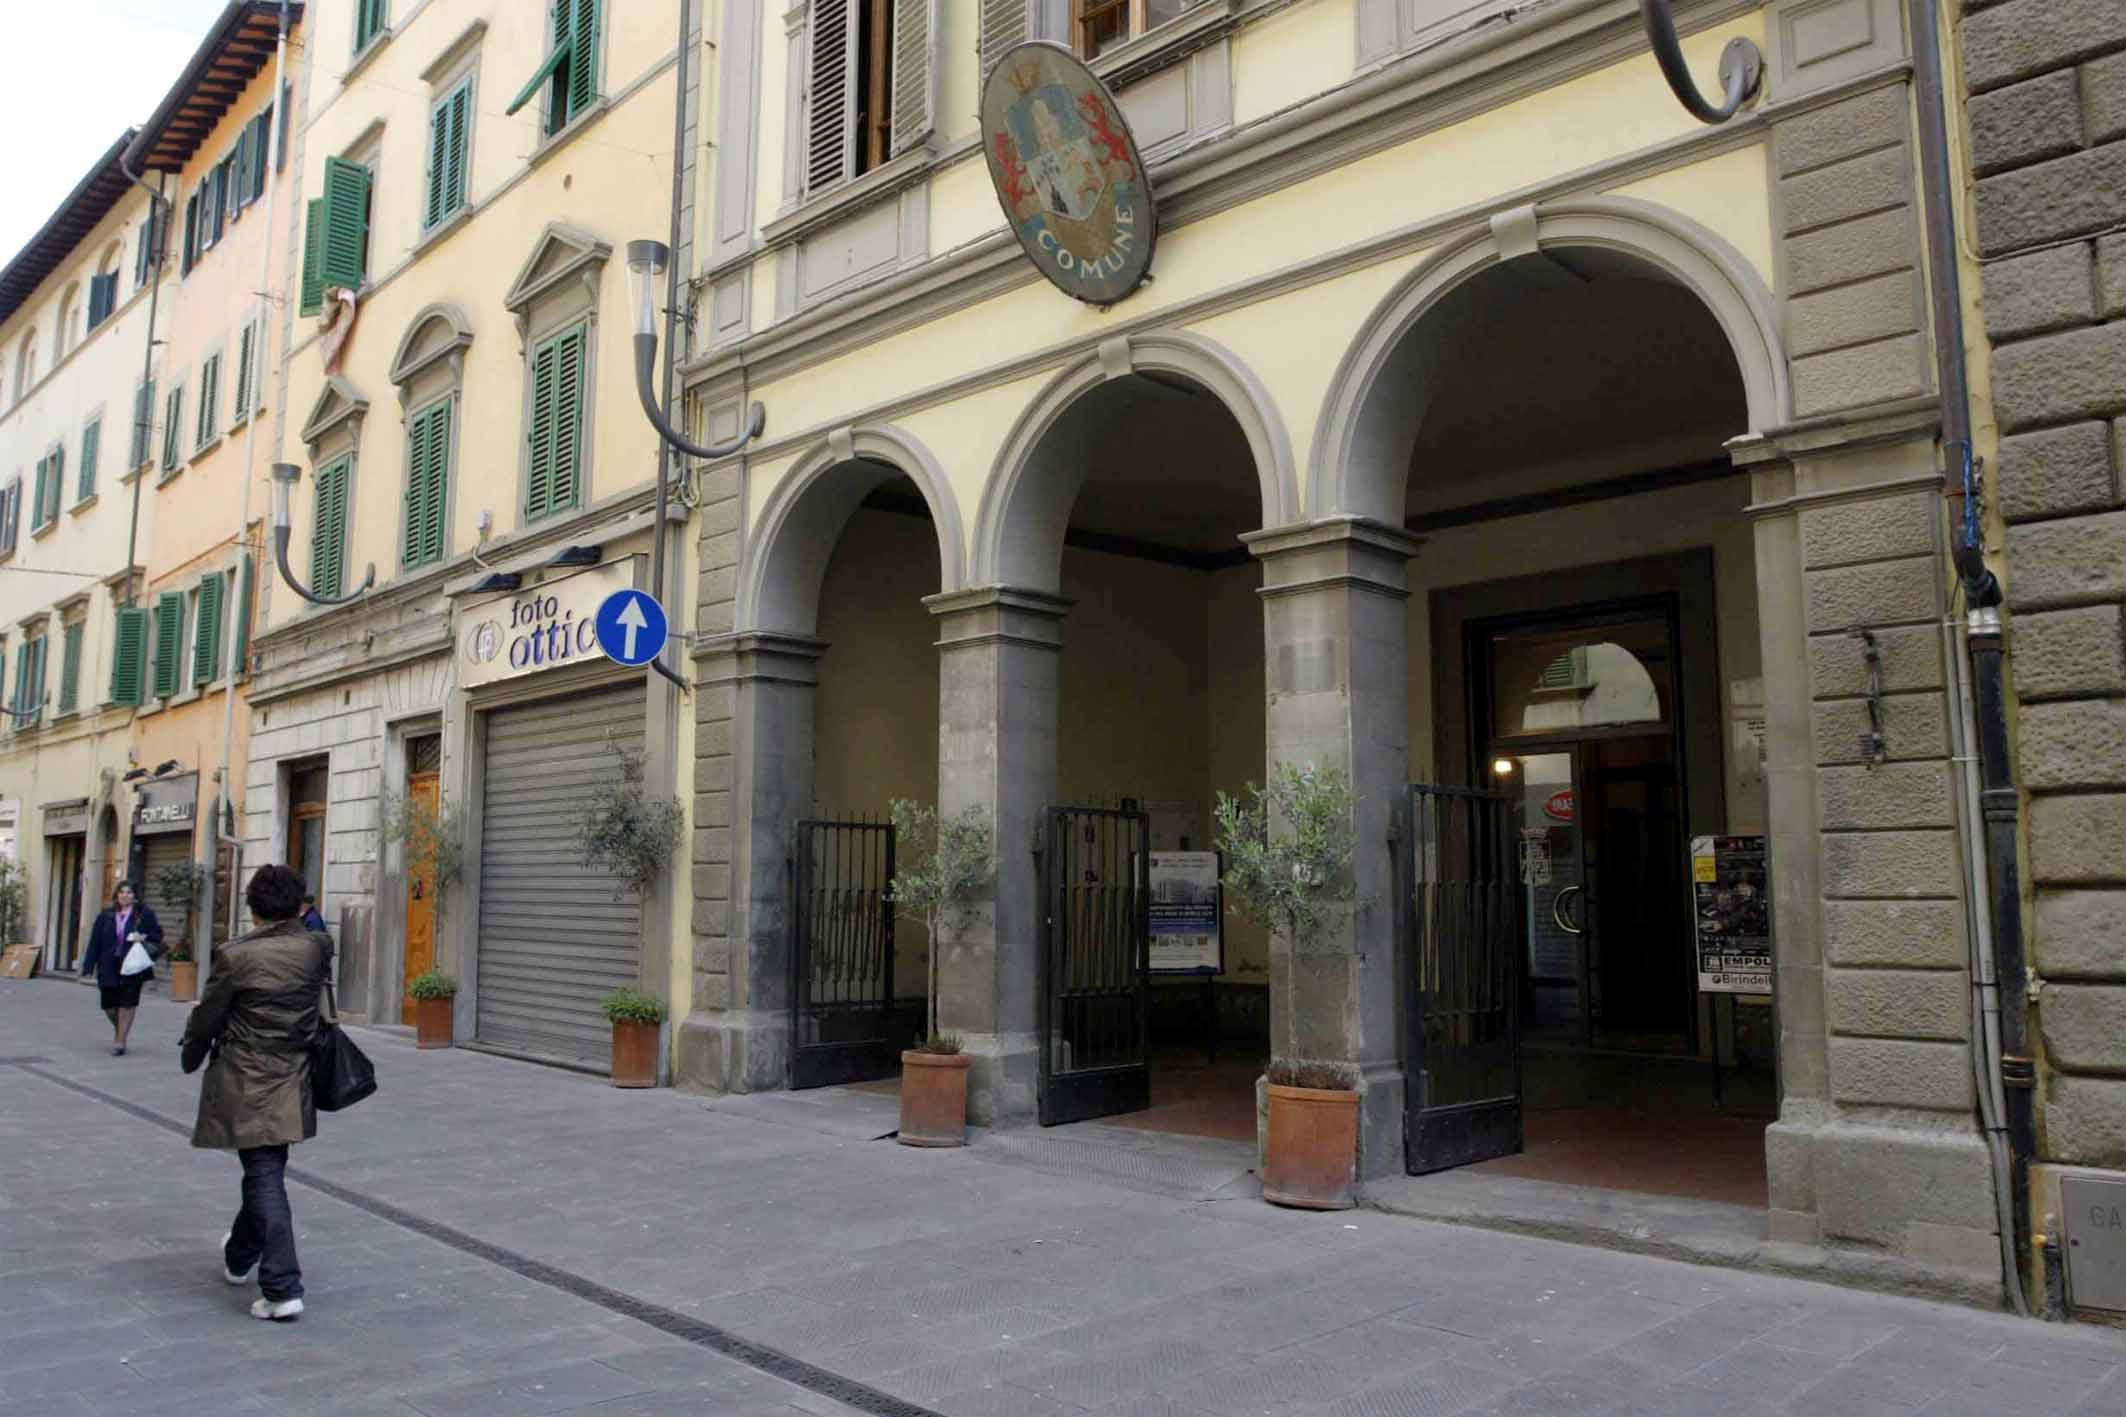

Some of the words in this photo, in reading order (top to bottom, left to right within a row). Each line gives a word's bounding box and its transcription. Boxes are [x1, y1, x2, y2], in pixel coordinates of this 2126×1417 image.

[1037, 206, 1135, 280] COMUNE
[510, 594, 559, 629] foto
[509, 609, 595, 671] ottic
[1724, 956, 1770, 966] EMPOL
[2089, 1205, 2124, 1231] GA
